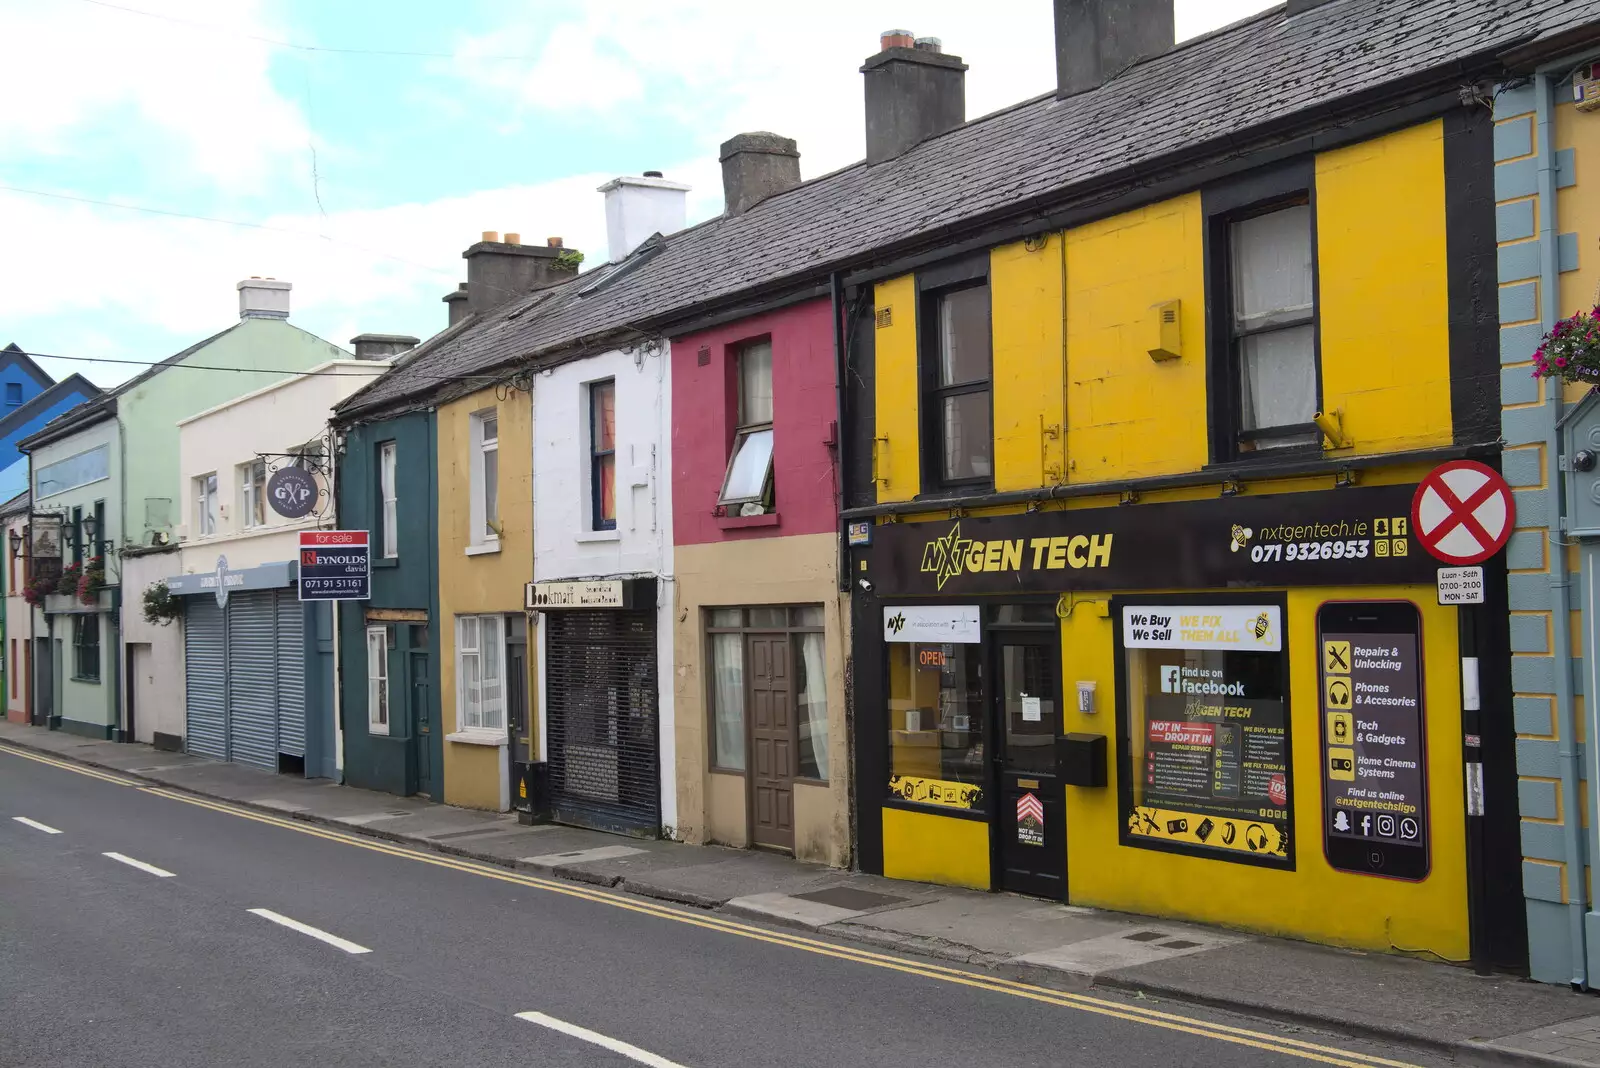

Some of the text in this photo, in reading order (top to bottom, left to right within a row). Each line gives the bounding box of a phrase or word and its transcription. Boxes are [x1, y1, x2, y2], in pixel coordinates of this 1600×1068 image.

[275, 487, 310, 500] G P
[1259, 519, 1368, 543] nxtgentech.ie
[315, 533, 353, 543] for sale
[1030, 533, 1113, 570] TECH
[1251, 540, 1370, 563] 071 9326953
[303, 551, 367, 565] REYNOLDS
[345, 564, 367, 573] david
[305, 579, 362, 588] 071 91 51161
[531, 585, 574, 605] Bookmart
[1465, 592, 1478, 600] SAT
[887, 611, 906, 635] NXT
[1131, 614, 1171, 628] We Buy
[1180, 615, 1222, 628] WE FIX
[1132, 629, 1172, 641] We Sell
[1180, 629, 1241, 643] THEM ALL
[1353, 646, 1399, 657] Repairs &
[919, 650, 946, 666] OPEN
[1354, 659, 1402, 671] Unlocking
[1181, 667, 1223, 678] find us on
[1181, 679, 1245, 696] facebook
[1355, 682, 1390, 693] Phones
[1355, 695, 1416, 706] & Accesories
[1223, 707, 1252, 718] TECH
[1151, 722, 1182, 732] NOT IN
[1356, 720, 1378, 730] Tech
[1164, 732, 1212, 744] DROP IT IN
[1356, 732, 1406, 745] & Gadgets
[1190, 745, 1212, 753] SERVICE
[1357, 756, 1416, 768] Home Cinema
[1358, 767, 1395, 778] Systems
[1347, 787, 1405, 801] Find us online
[1335, 796, 1416, 813] @nxtgentechsligo
